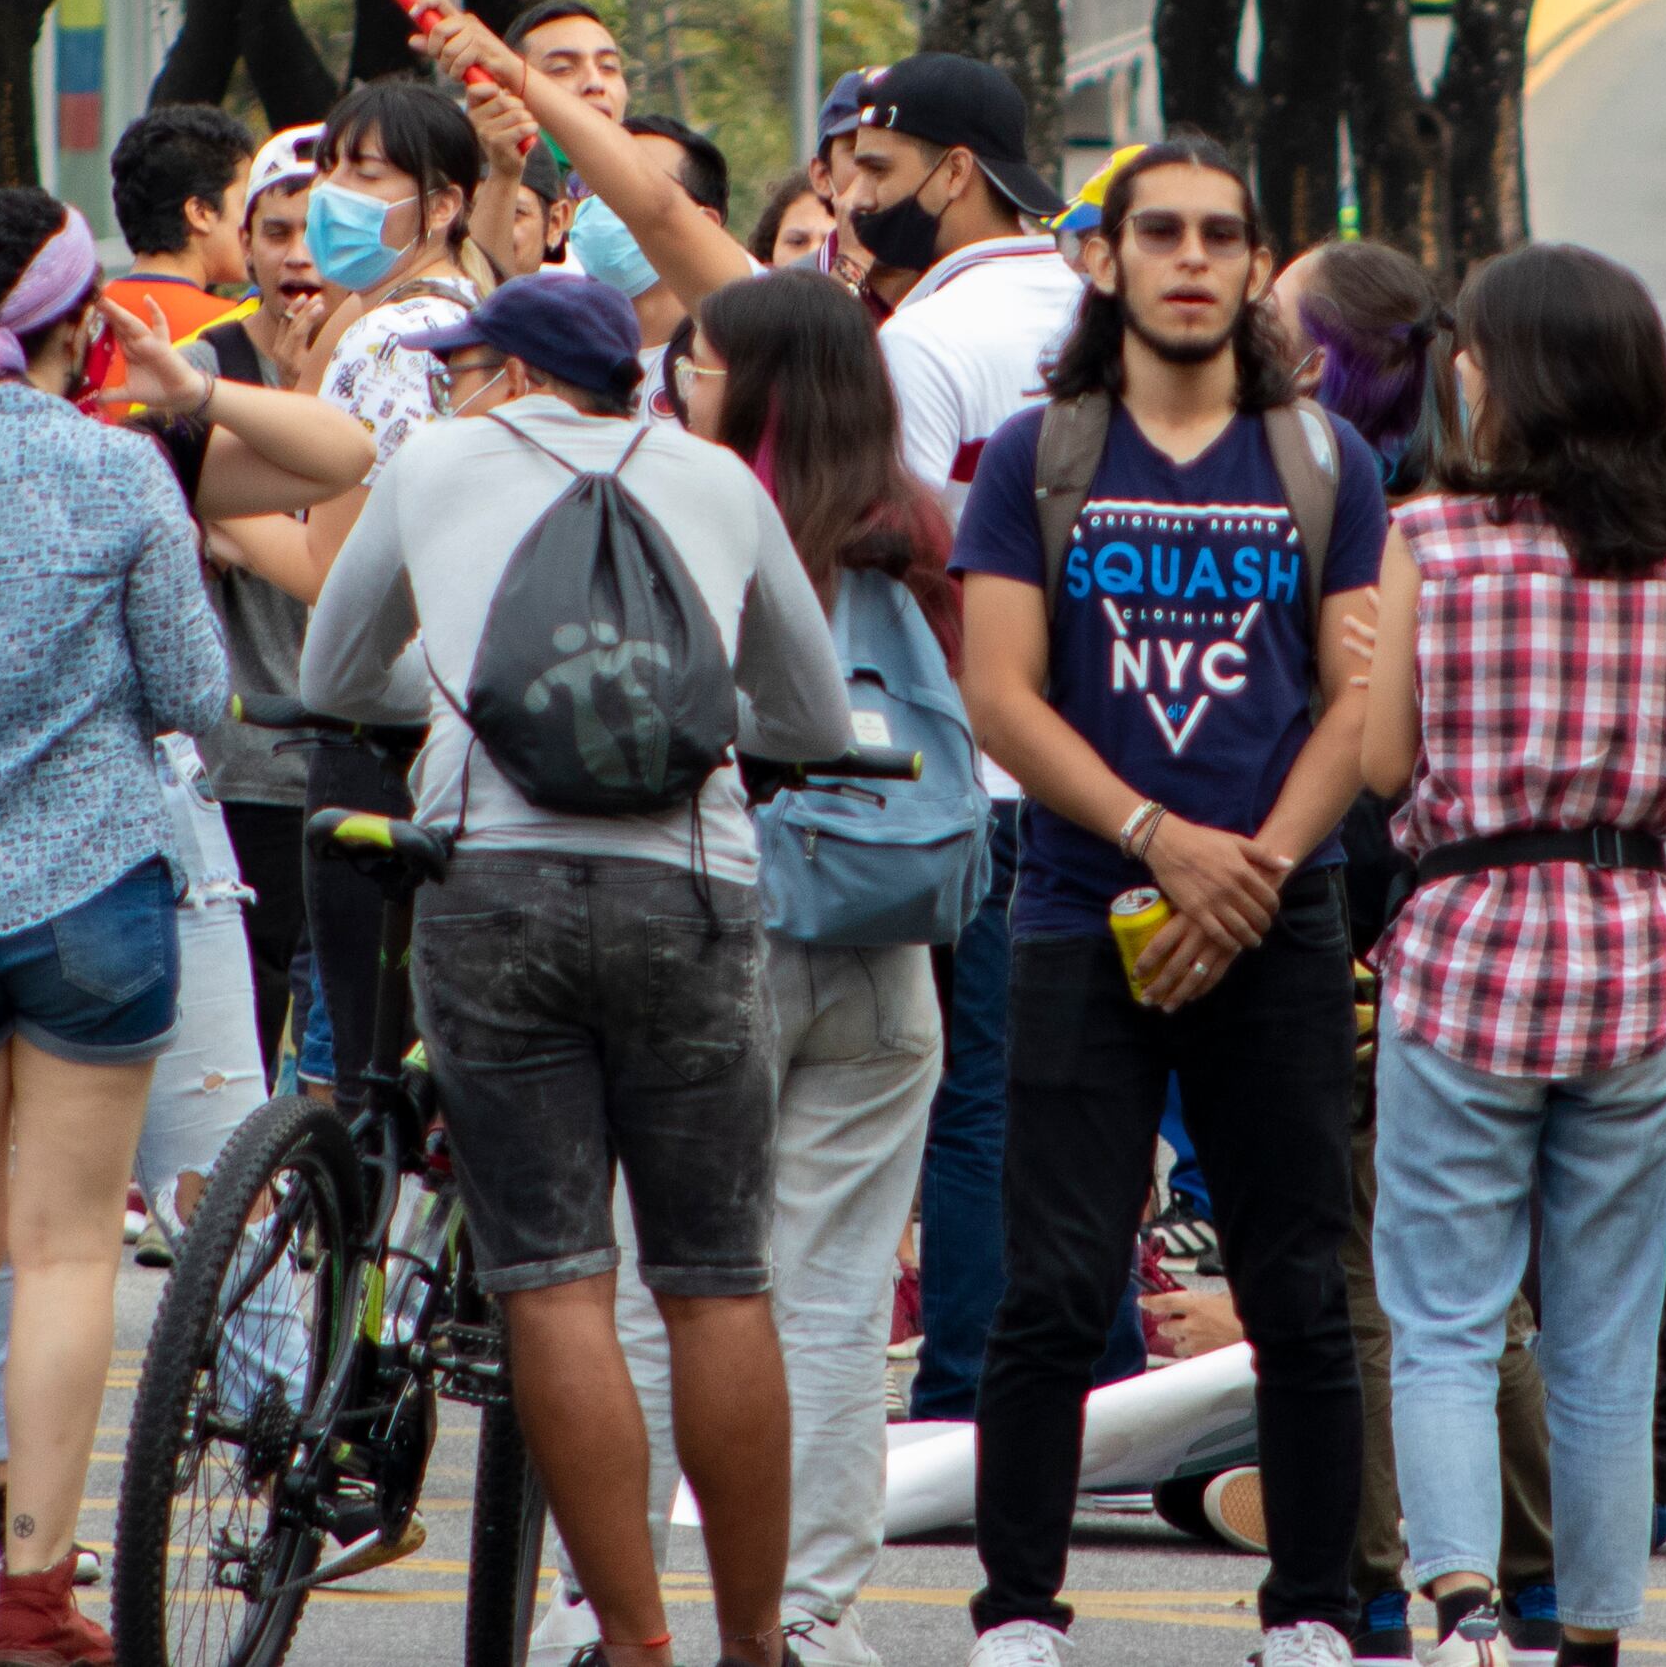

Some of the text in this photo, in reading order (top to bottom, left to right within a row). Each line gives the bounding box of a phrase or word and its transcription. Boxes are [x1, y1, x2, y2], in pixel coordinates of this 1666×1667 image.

[1090, 514, 1278, 533] ORIGINAL BRAND
[1066, 541, 1300, 604] SQUASH
[1122, 608, 1242, 625] CLOTHING
[1113, 638, 1247, 692] NYC
